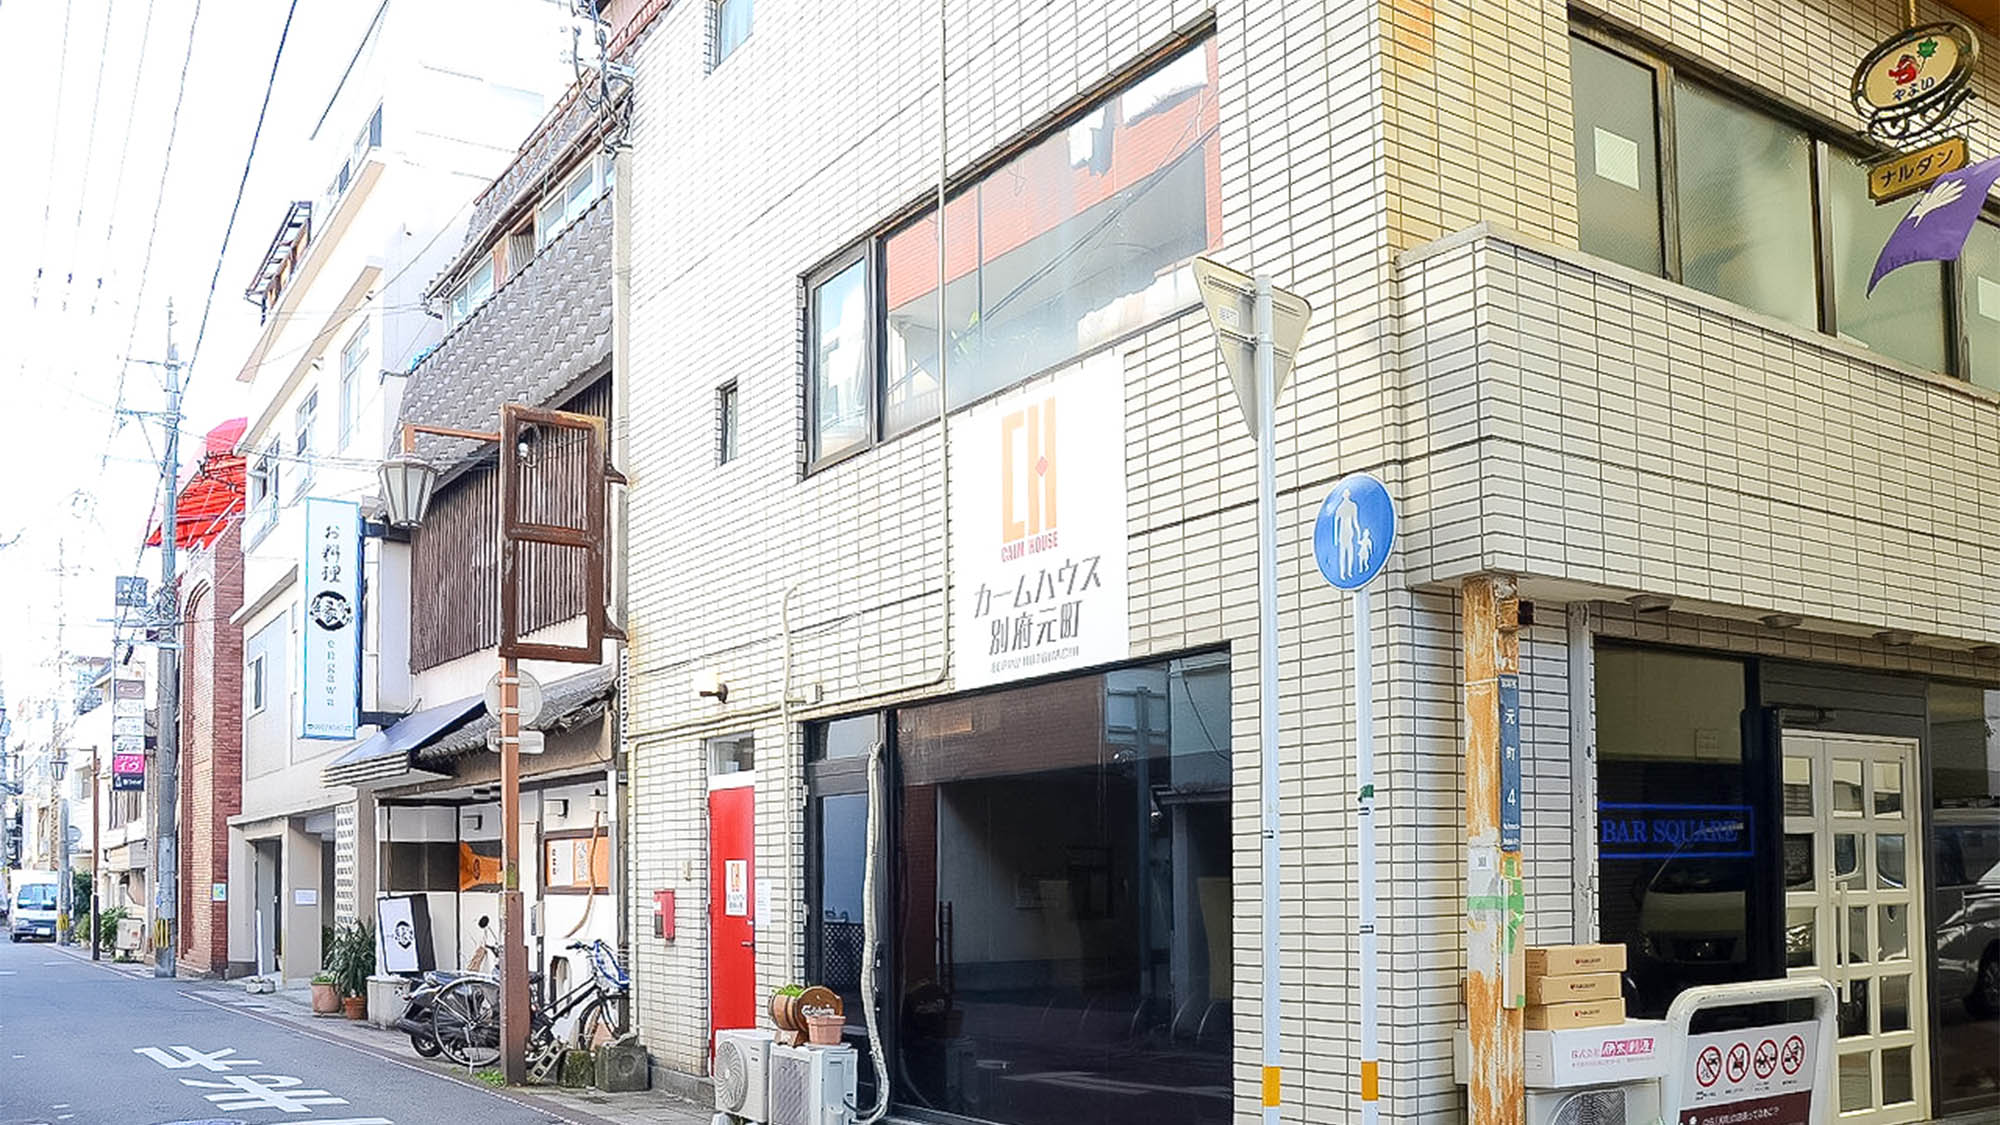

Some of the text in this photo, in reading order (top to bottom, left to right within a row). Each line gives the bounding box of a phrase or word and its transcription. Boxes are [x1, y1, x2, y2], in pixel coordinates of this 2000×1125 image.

[1880, 148, 1954, 188] ナルダン
[321, 525, 341, 583] お料理
[1028, 531, 1058, 554] HOUSE
[974, 555, 1101, 618] カームハウス
[989, 600, 1082, 655] 別府元町
[1601, 818, 1738, 847] BAR SQUARE
